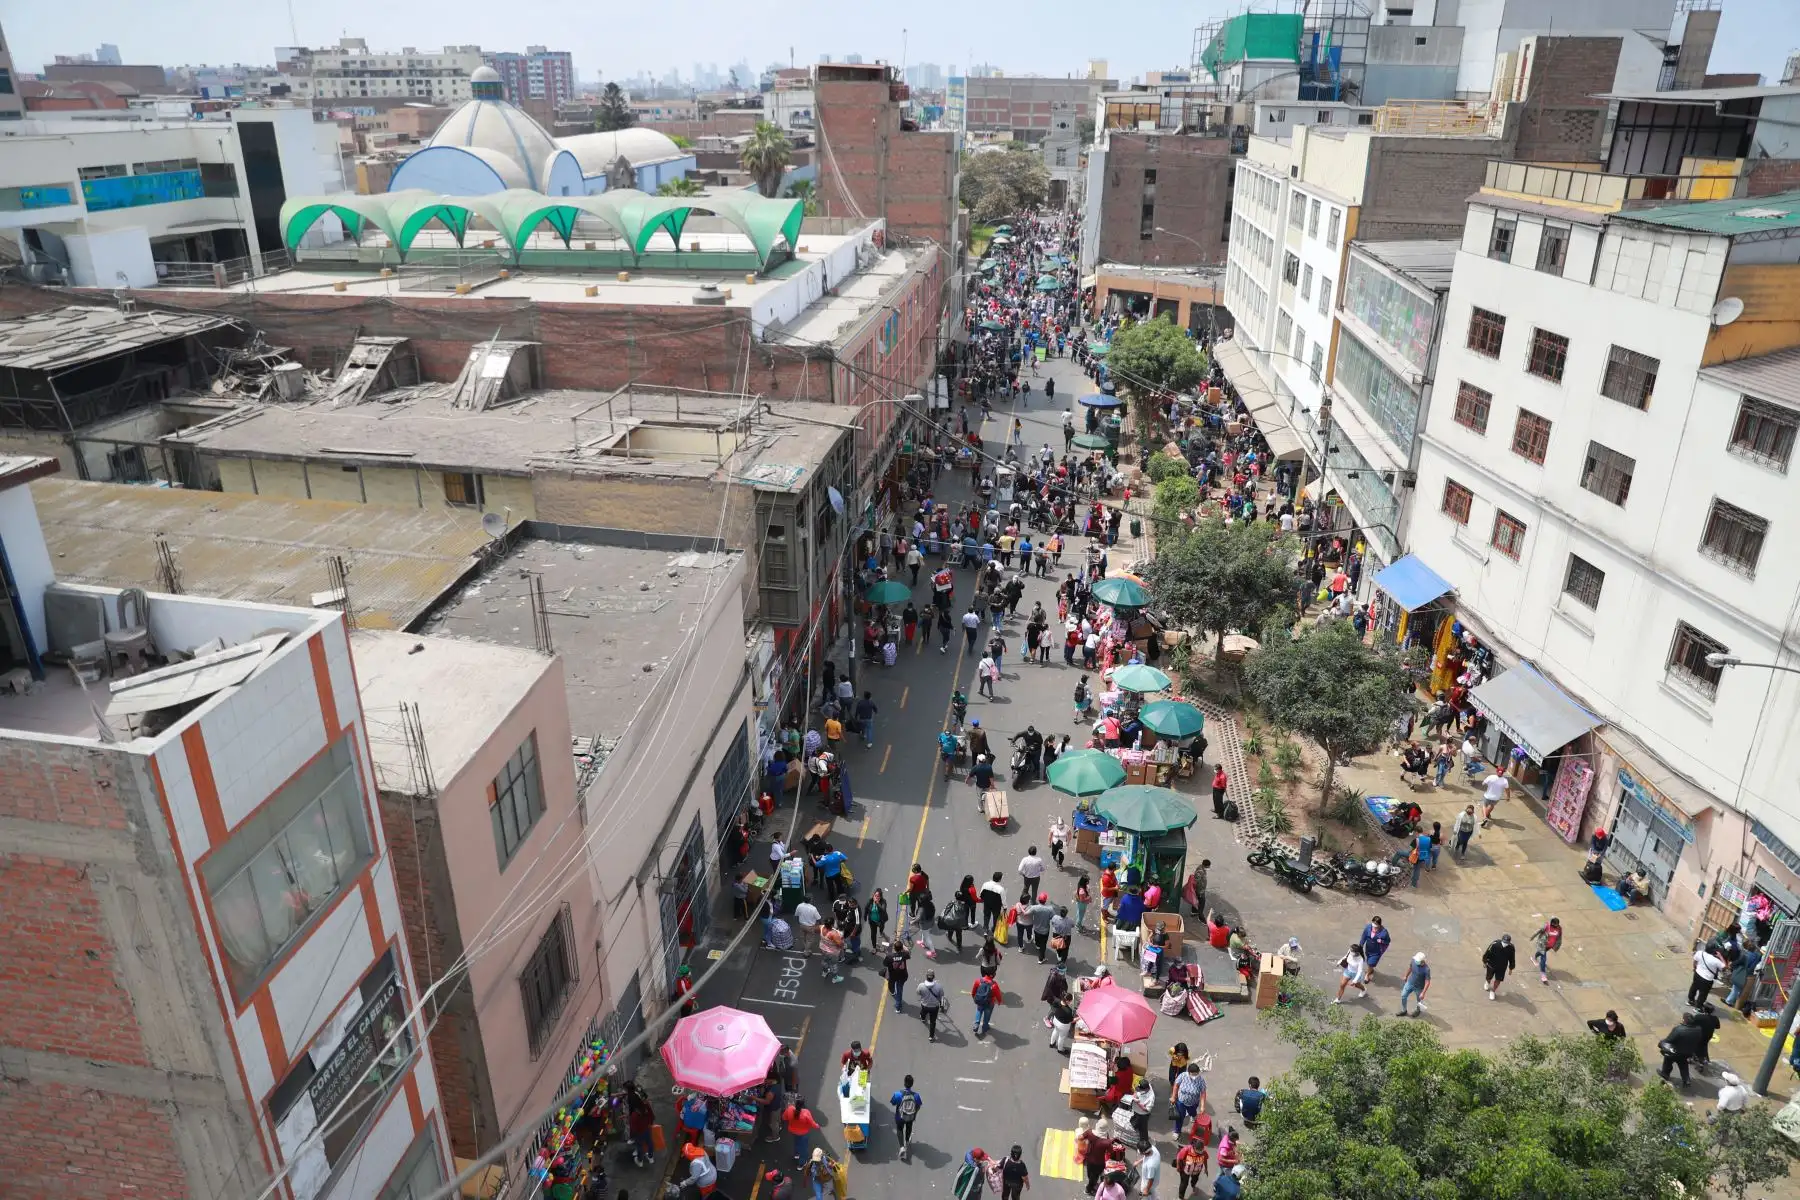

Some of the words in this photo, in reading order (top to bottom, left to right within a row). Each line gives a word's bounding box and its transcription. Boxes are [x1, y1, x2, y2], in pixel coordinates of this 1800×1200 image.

[773, 956, 808, 1000] PASE
[310, 1047, 347, 1099] CORTES
[346, 1035, 359, 1051] EL
[358, 984, 395, 1036] CABELLO
